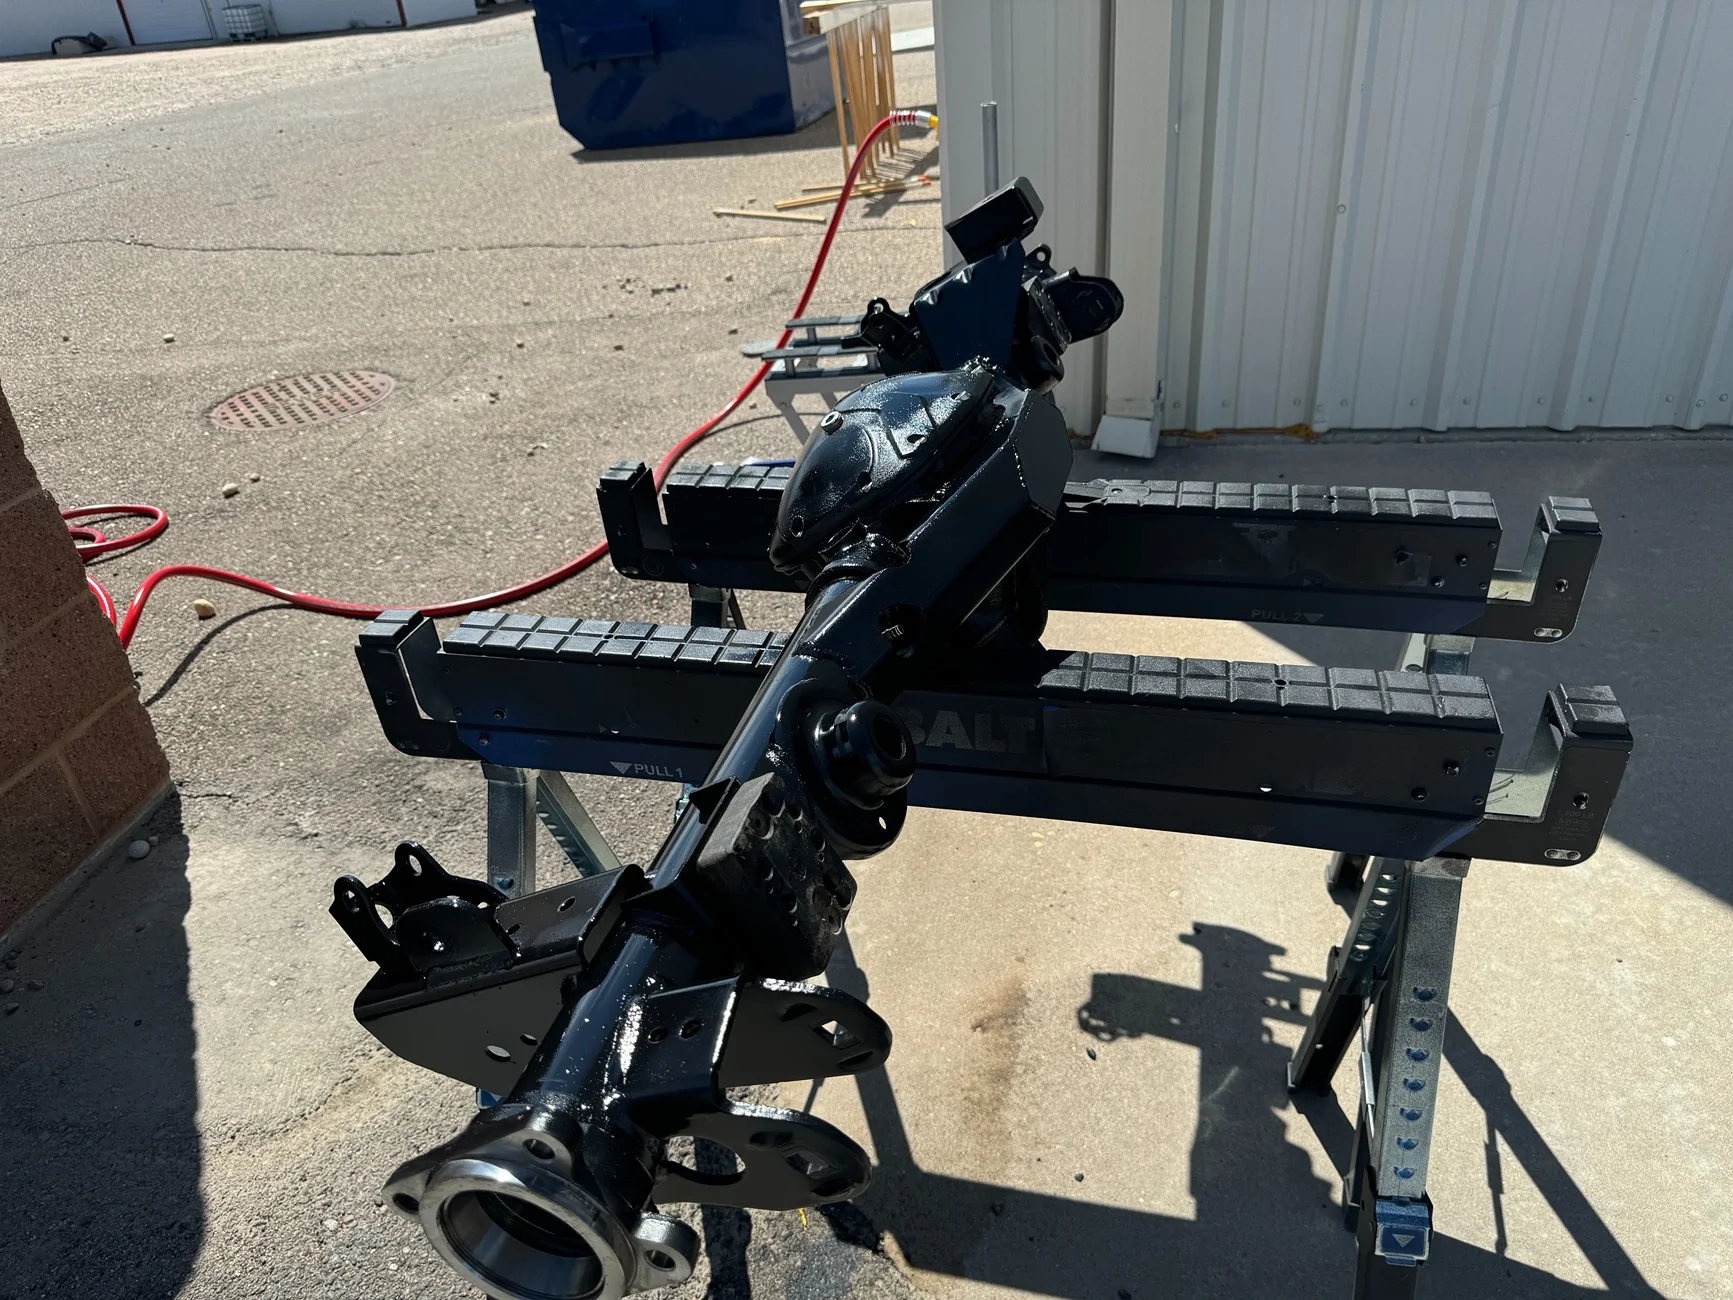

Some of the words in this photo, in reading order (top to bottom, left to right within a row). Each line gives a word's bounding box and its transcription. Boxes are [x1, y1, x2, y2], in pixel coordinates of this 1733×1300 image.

[1251, 608, 1288, 621] PULL
[1292, 611, 1302, 622] 2
[633, 763, 674, 777] PULL
[675, 767, 683, 778] 1
